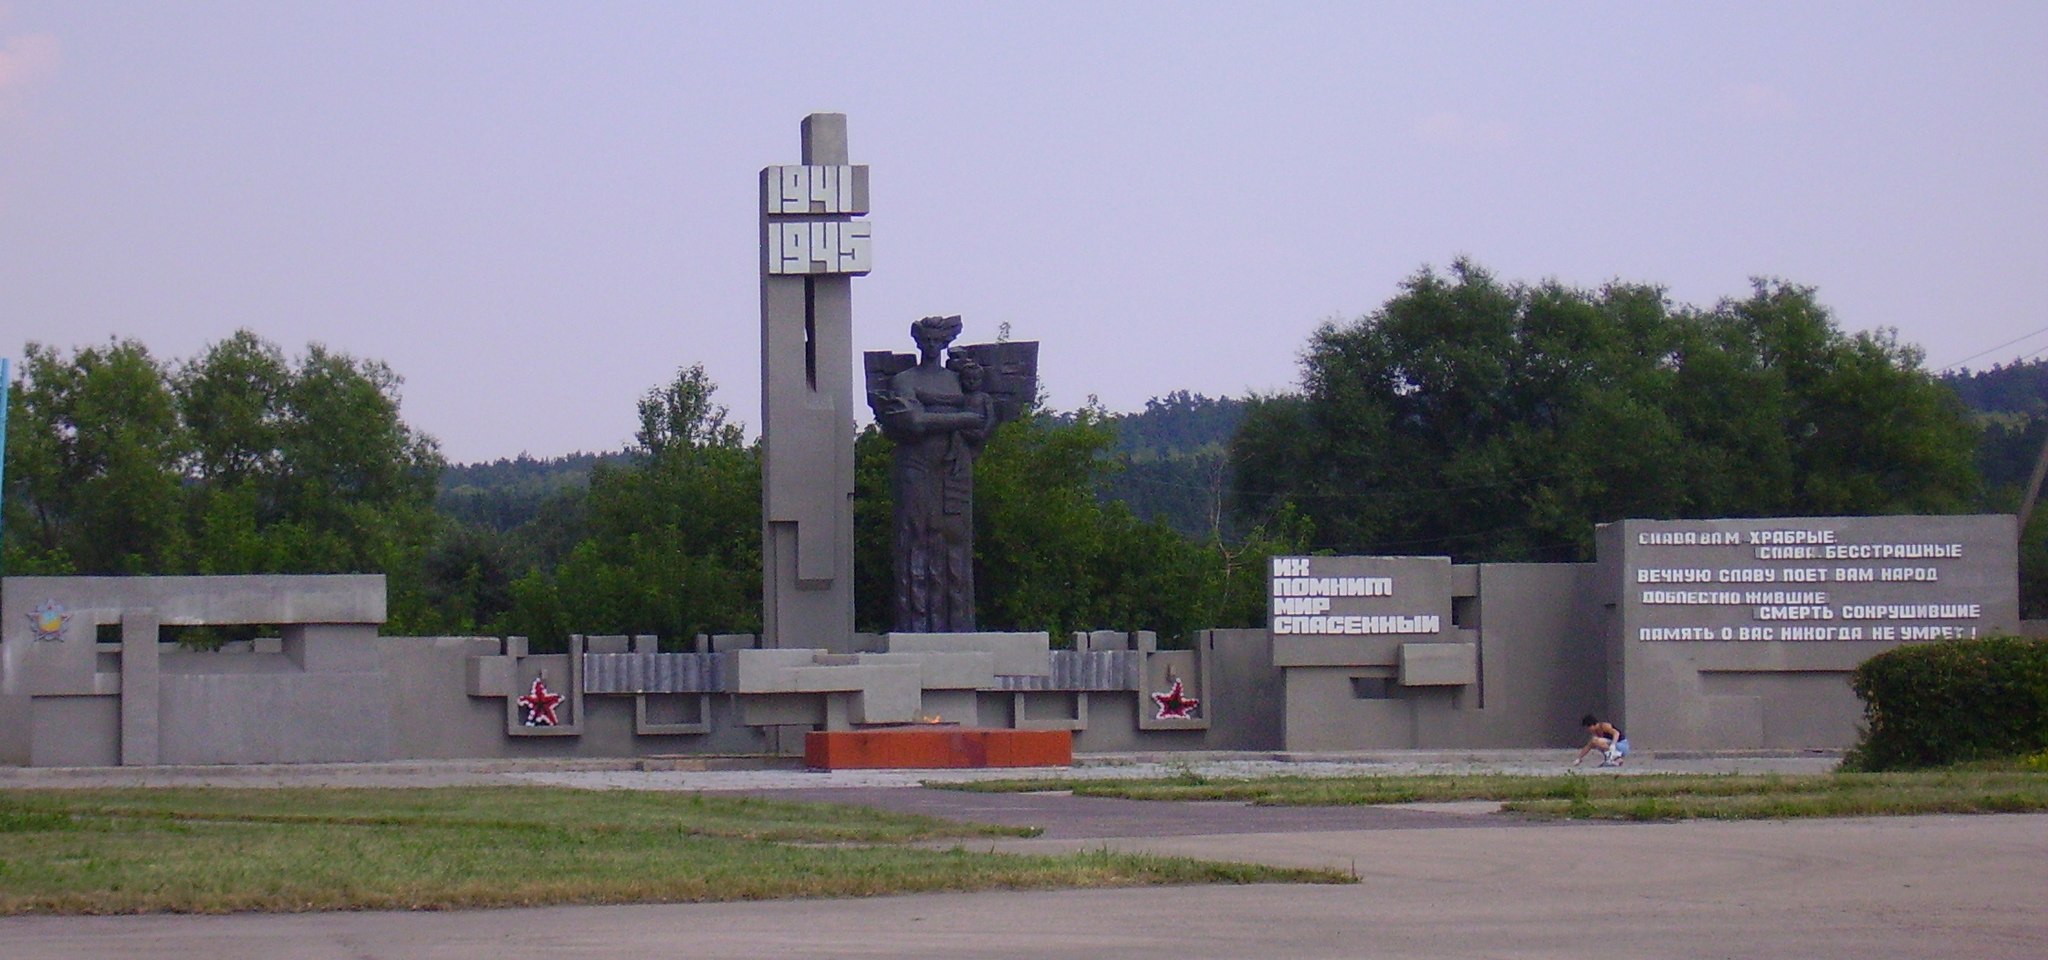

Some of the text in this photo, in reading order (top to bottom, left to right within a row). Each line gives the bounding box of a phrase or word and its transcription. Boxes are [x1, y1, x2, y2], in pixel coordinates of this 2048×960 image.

[768, 165, 852, 213] 1941
[768, 222, 871, 274] 1945
[1701, 532, 1740, 545] ВАМ
[1825, 543, 1962, 559] БЕССТРАШНЫЕ
[1273, 558, 1310, 577] ИХ
[1637, 567, 1938, 583] ВЕЧНУЮ СЛАВУ ПОЕТ ВАМ НАРОД
[1273, 577, 1392, 597] ПОМНИТ
[1643, 590, 1826, 605] ДОБЛЕСТНО ЖИВШИЕ
[1274, 597, 1331, 615] МИР
[1760, 604, 1981, 620] СМЕРТЬ СОКРУШИВШИЕ
[1639, 627, 1715, 641] ПАМЯТЬ
[1721, 626, 1733, 641] О
[1739, 626, 1773, 641] ВАС
[1781, 626, 1863, 641] НИКОГДА
[1872, 626, 1895, 641] НЕ
